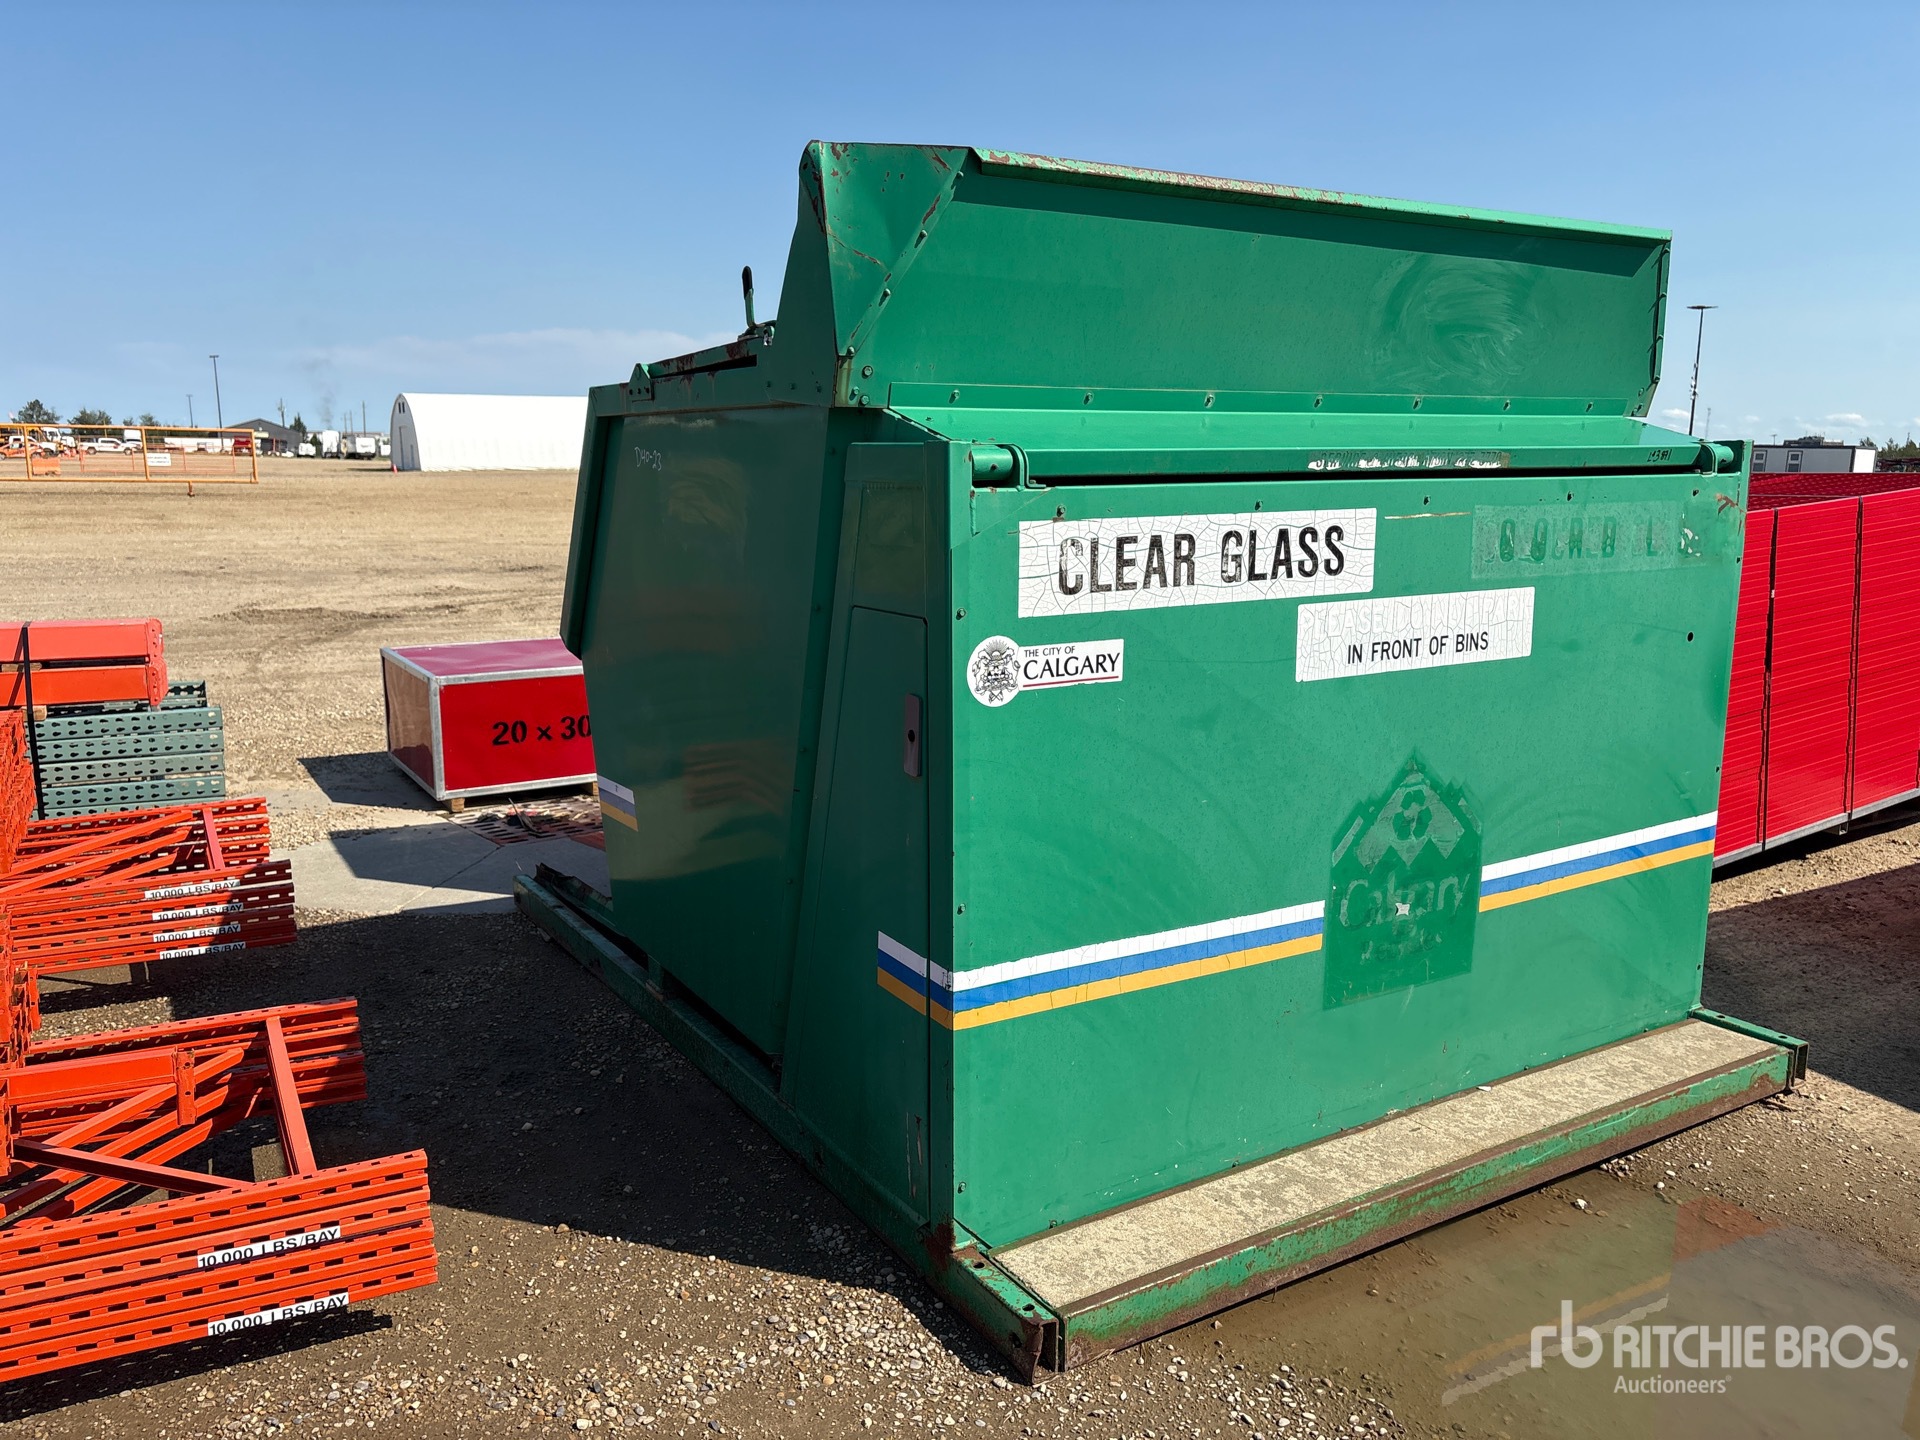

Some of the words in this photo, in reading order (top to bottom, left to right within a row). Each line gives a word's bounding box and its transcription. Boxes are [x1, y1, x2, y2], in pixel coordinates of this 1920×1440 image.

[1058, 533, 1197, 595] CLEAR
[1220, 525, 1345, 583] GLASS
[1024, 648, 1039, 658] THE
[1042, 646, 1062, 656] CITY
[1064, 645, 1076, 654] OF
[1347, 644, 1363, 664] IN
[1371, 638, 1422, 662] FRONT
[1429, 635, 1449, 655] OF
[1455, 631, 1489, 653] BINS
[1023, 652, 1120, 680] CALGARY
[492, 720, 527, 746] 20
[560, 714, 592, 740] 30
[261, 1228, 338, 1255] LBS/BAY
[270, 1295, 347, 1320] LBS/BAY
